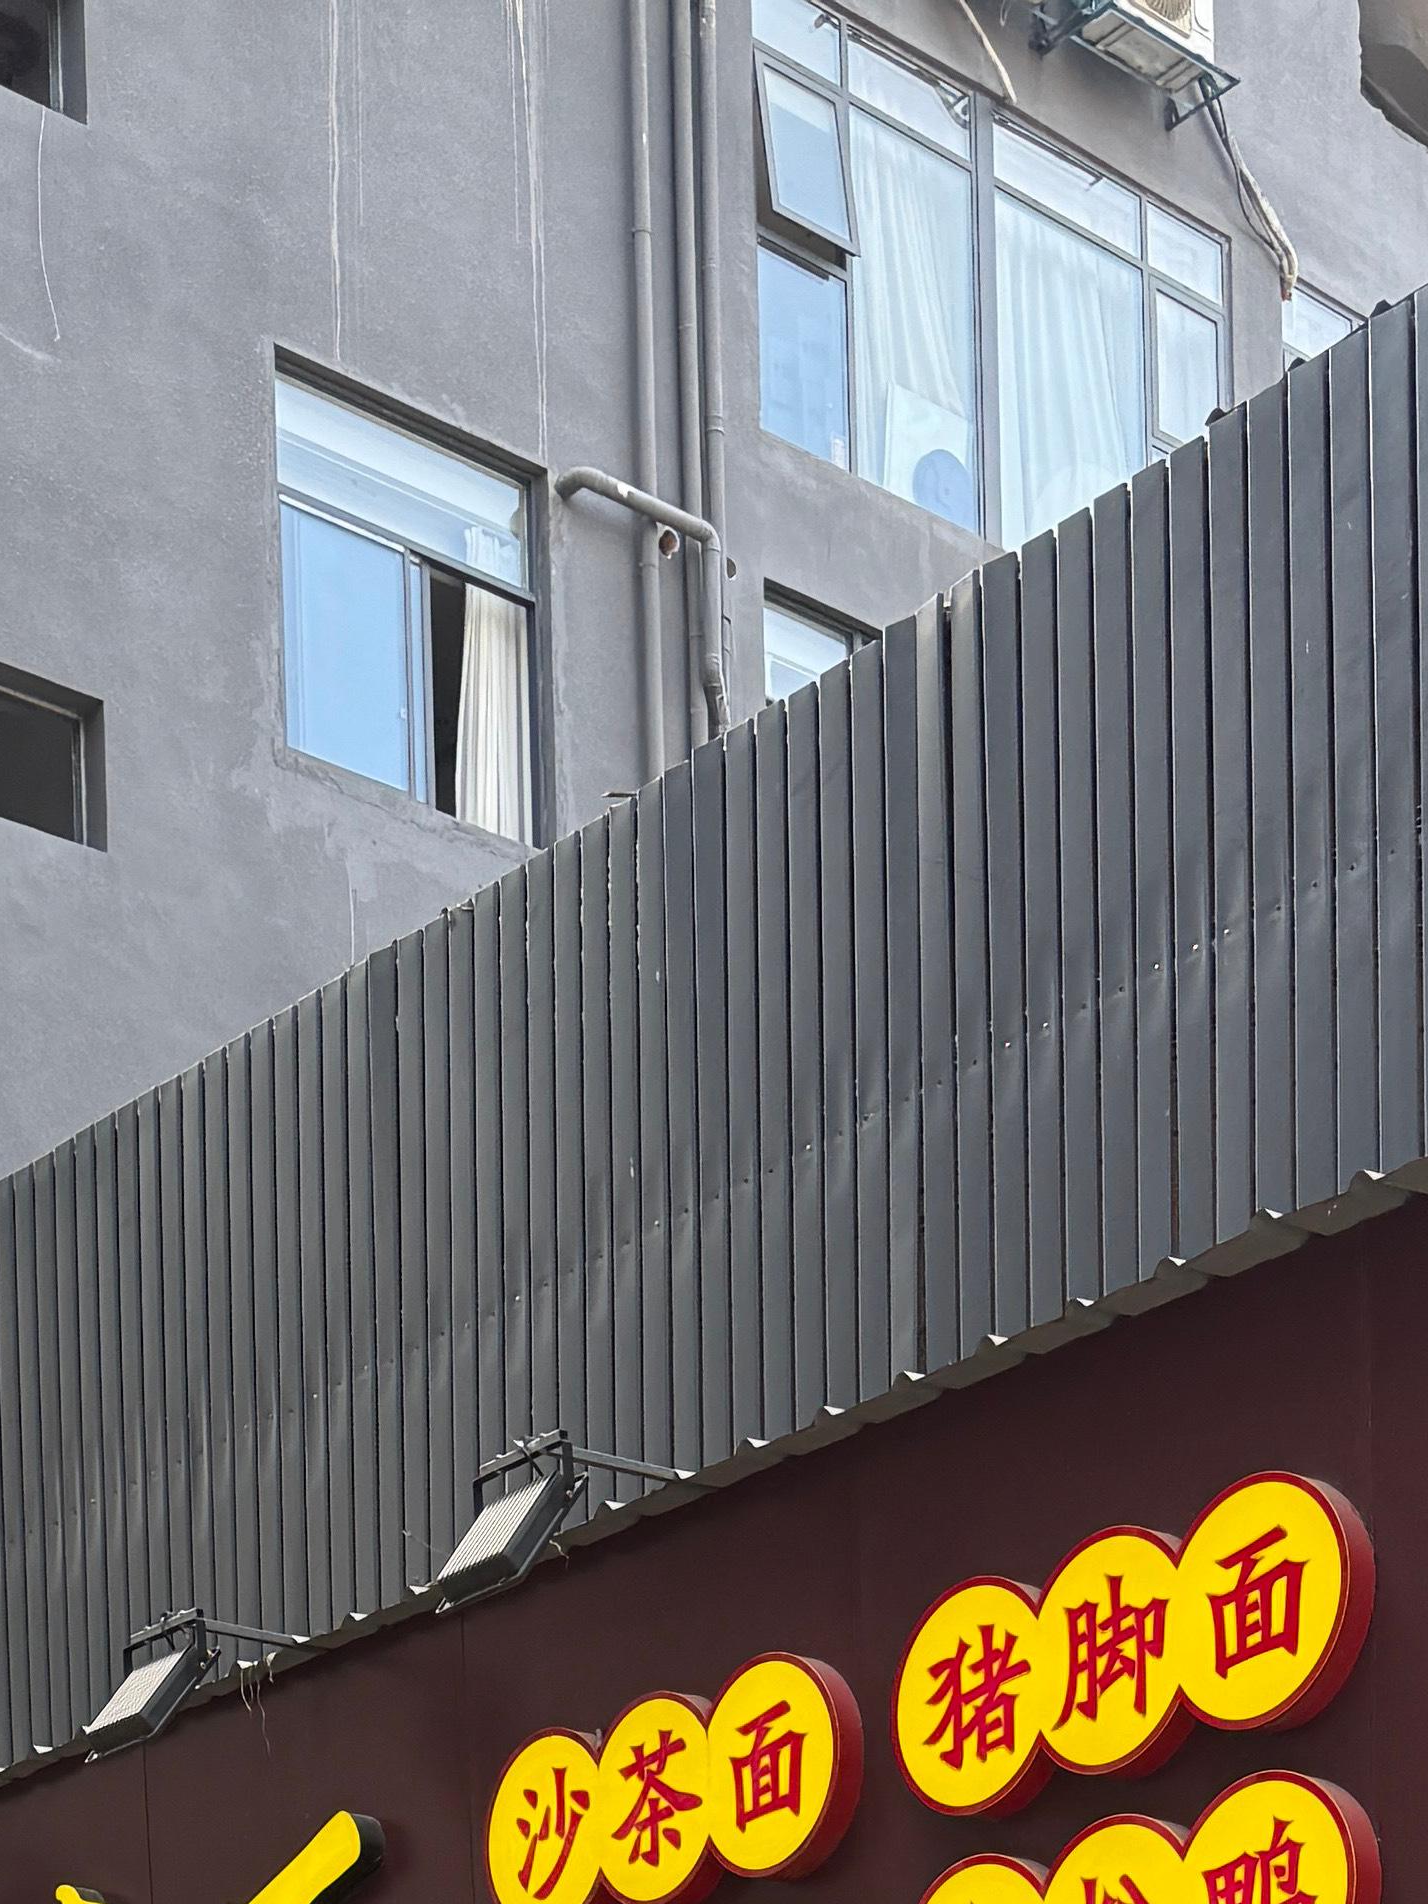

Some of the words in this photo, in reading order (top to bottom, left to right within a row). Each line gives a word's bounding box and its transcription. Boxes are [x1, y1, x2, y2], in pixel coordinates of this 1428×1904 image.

[925, 1526, 1310, 1770] 猪脚面
[516, 1698, 811, 1901] 沙茶面
